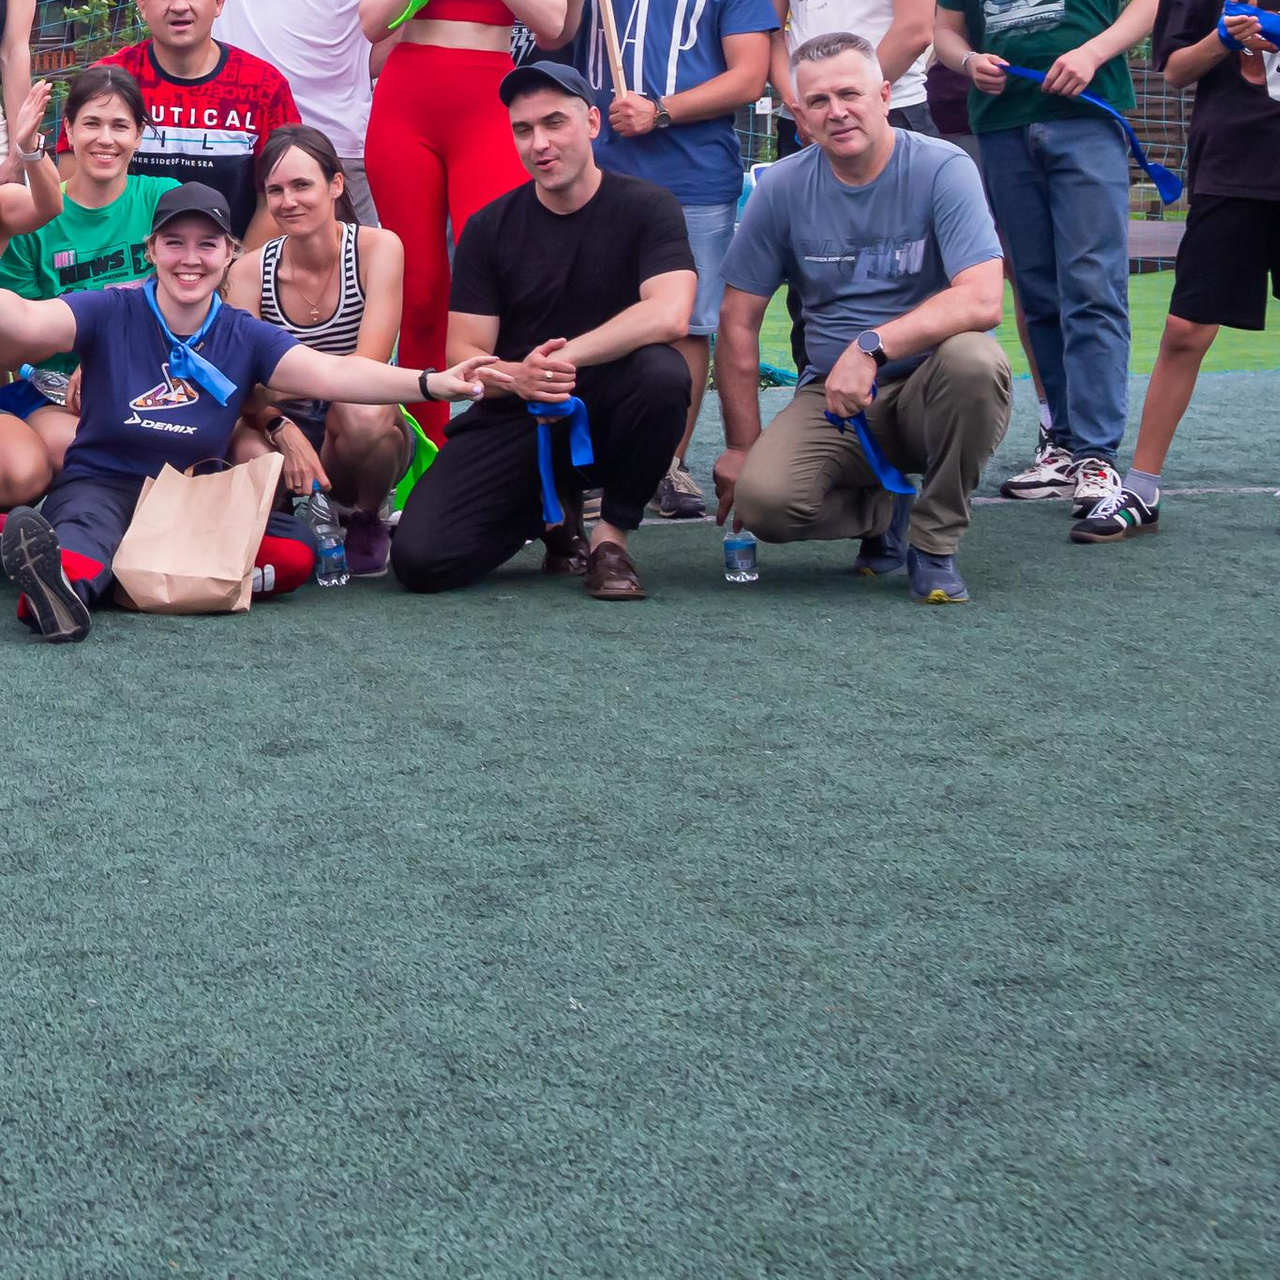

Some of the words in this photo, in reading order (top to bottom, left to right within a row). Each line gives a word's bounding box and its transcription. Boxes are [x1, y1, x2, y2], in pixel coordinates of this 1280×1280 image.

[151, 105, 256, 130] UTICAL
[151, 157, 170, 166] SIDE
[181, 159, 196, 168] THE
[198, 160, 214, 168] SEA
[140, 419, 198, 435] DEMIX
